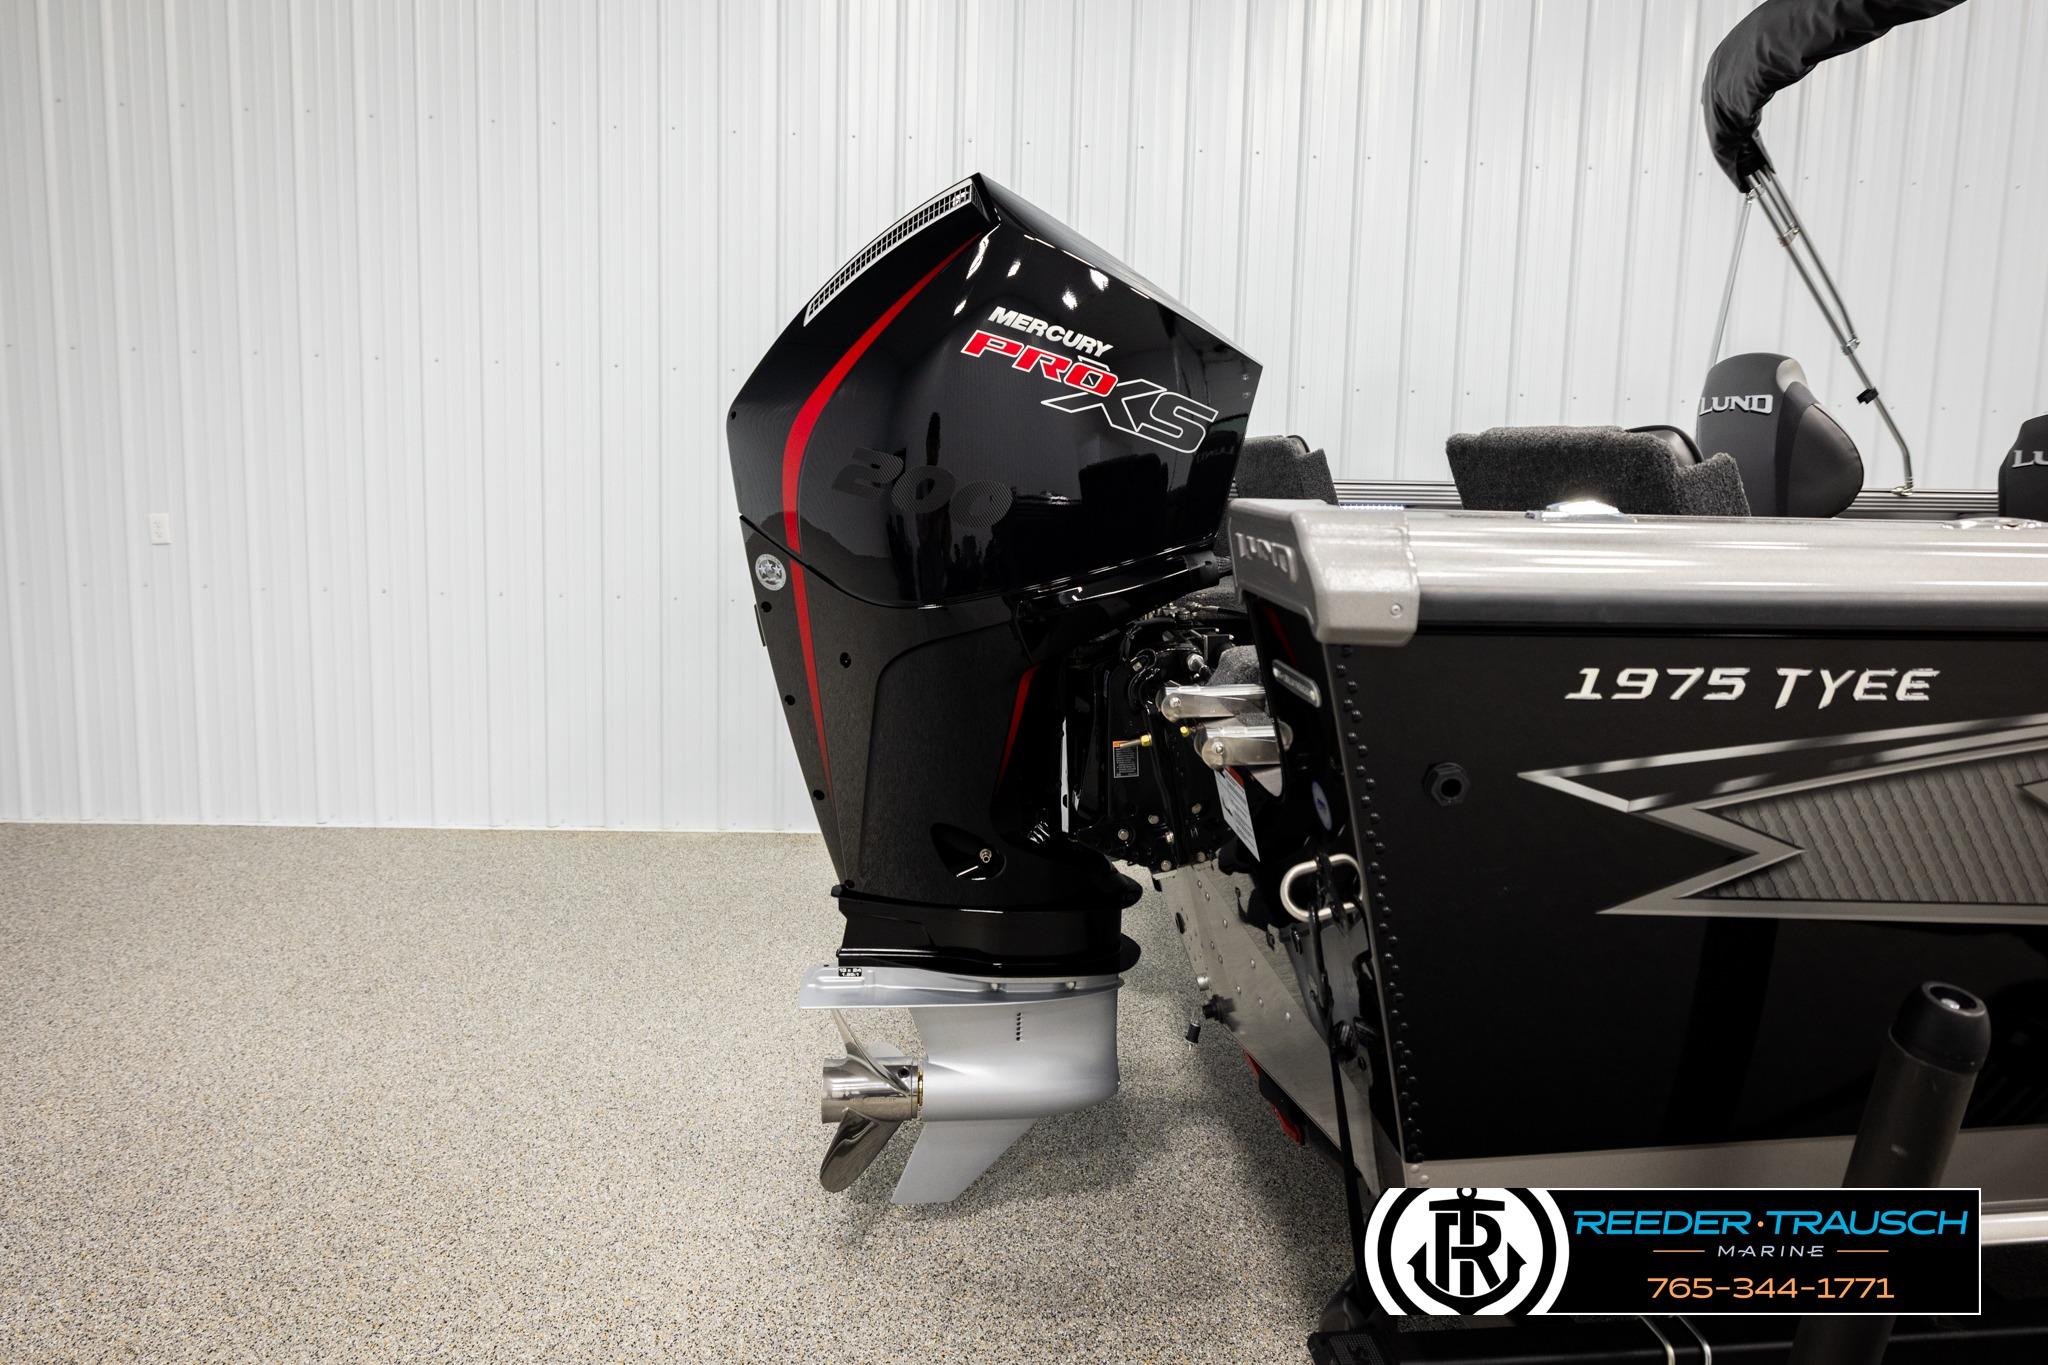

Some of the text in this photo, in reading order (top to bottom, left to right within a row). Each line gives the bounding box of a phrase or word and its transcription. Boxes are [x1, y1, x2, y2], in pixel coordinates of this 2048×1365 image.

[988, 306, 1113, 358] MERCURY
[960, 329, 1219, 453] PRO XS
[1699, 394, 1773, 416] LUND
[832, 447, 1013, 529] 200
[1565, 667, 1940, 710] 1975 TYEE
